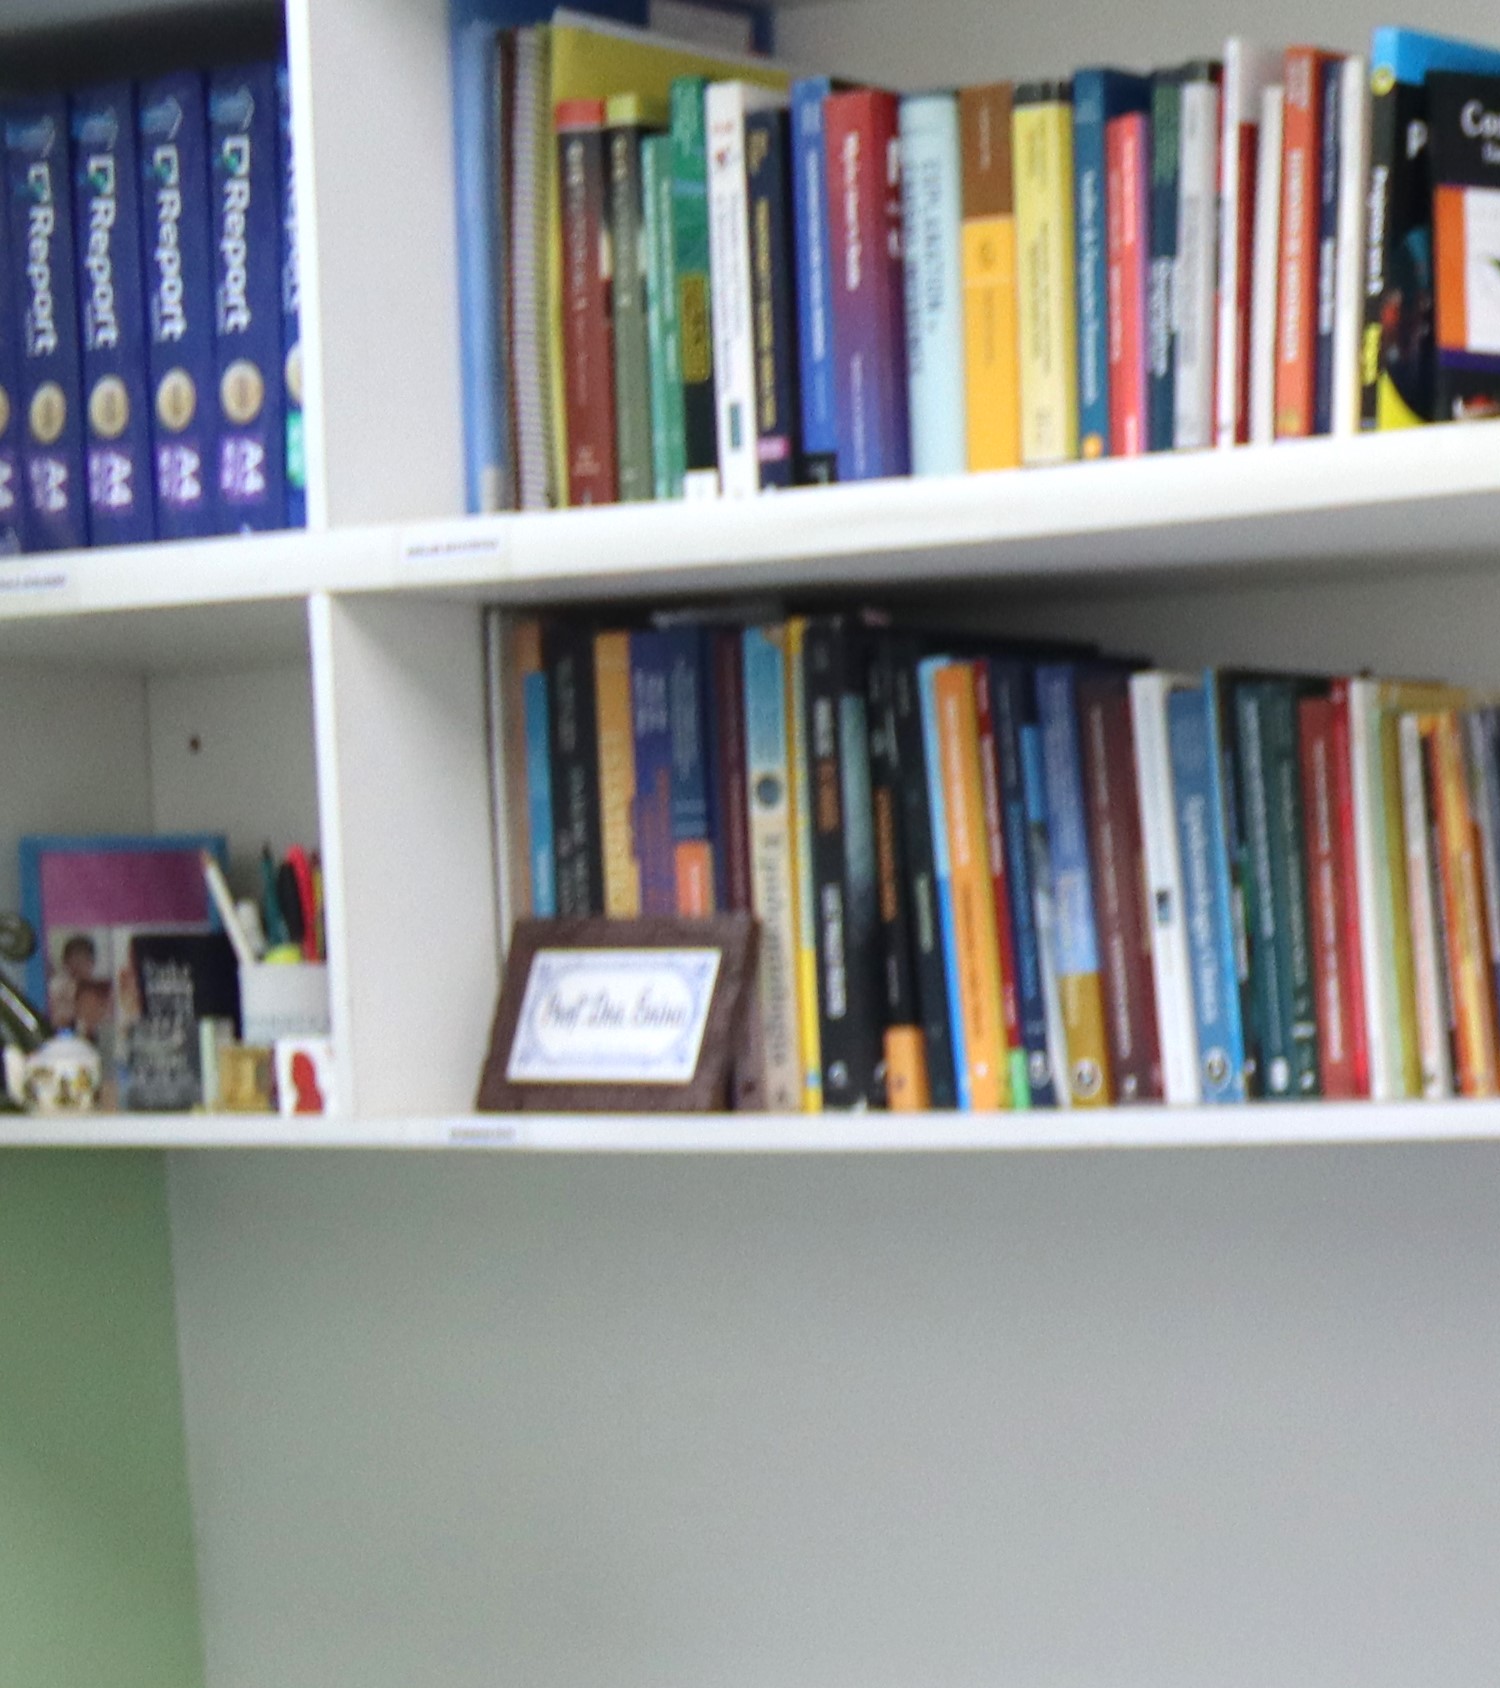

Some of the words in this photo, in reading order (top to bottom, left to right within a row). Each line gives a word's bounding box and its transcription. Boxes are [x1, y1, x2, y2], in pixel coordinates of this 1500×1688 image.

[28, 206, 58, 357] Report
[84, 196, 118, 351] Report
[155, 188, 187, 343] Report
[220, 177, 252, 334] Report
